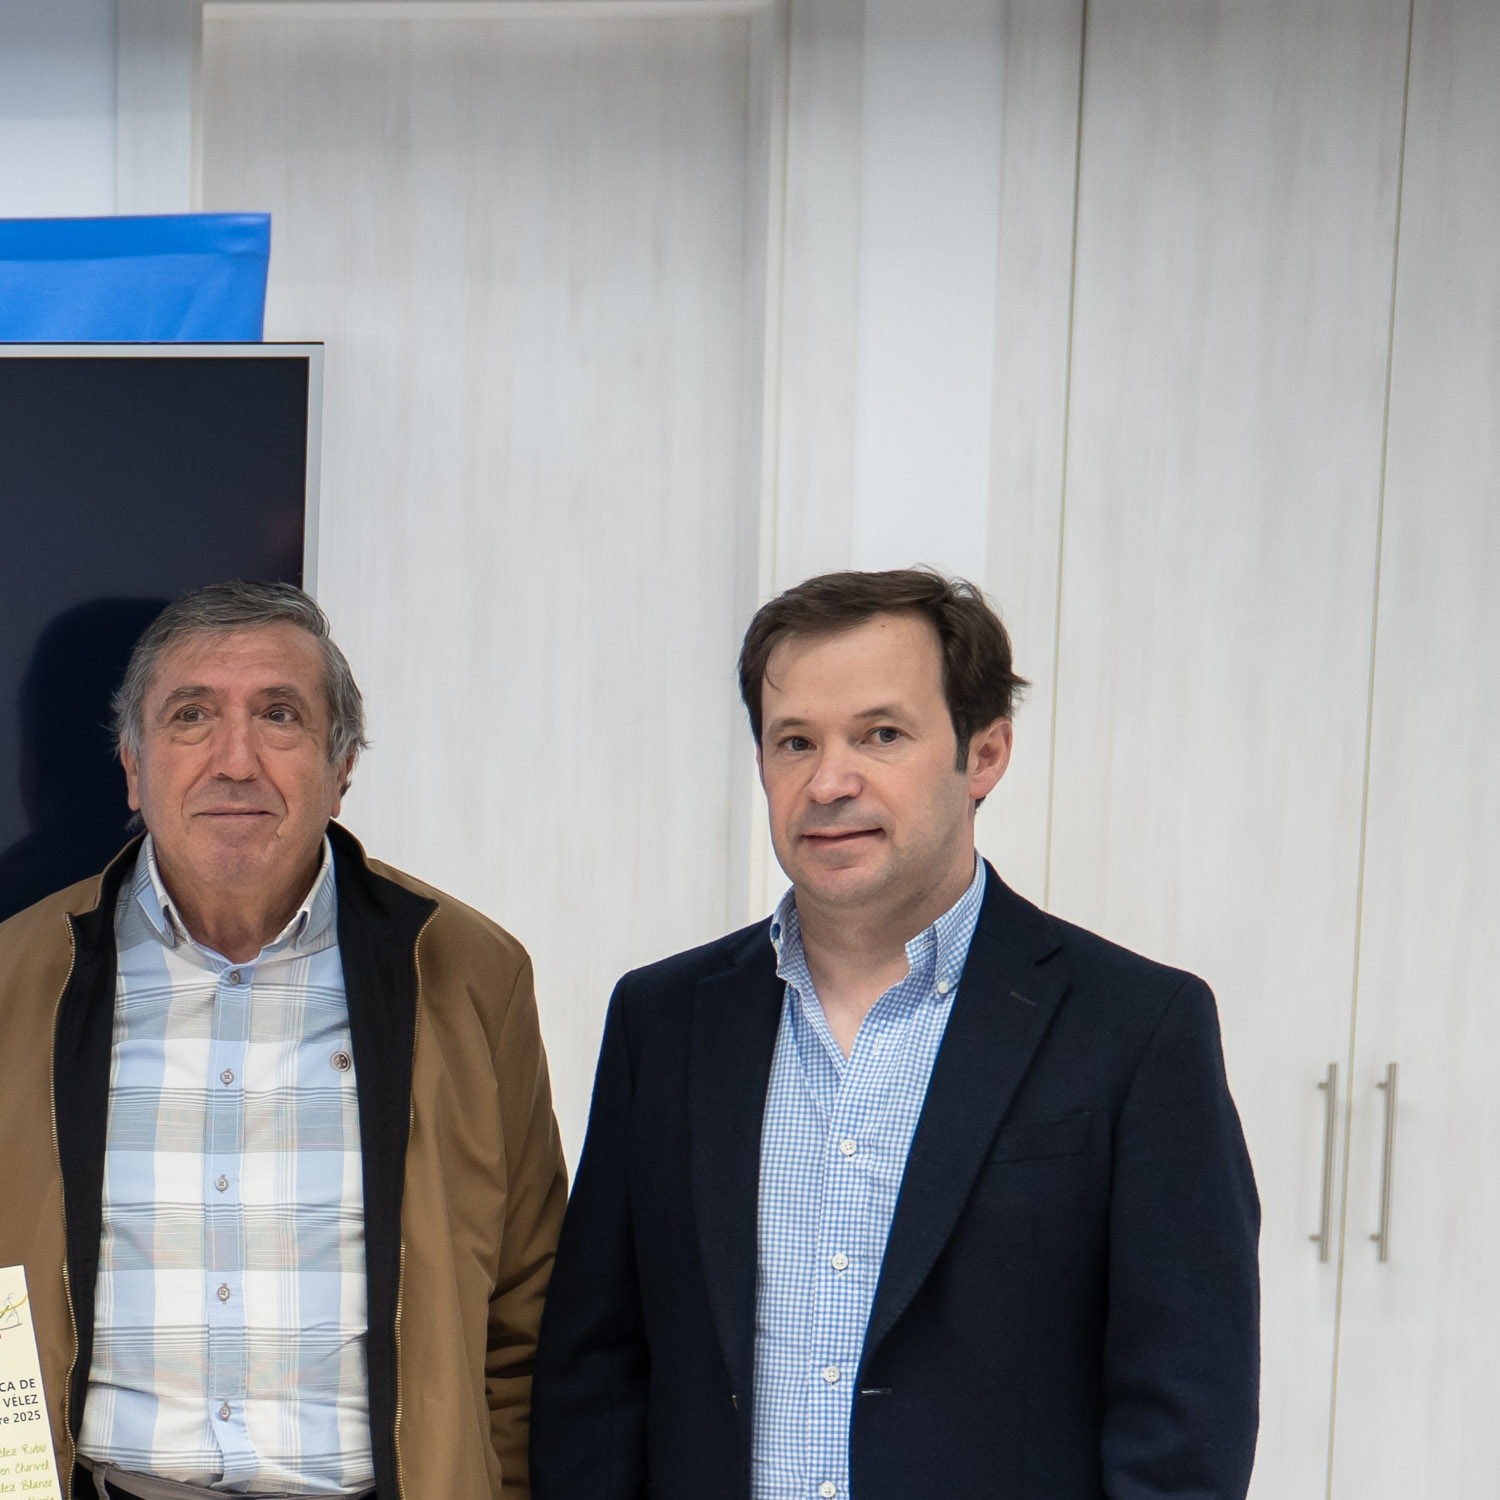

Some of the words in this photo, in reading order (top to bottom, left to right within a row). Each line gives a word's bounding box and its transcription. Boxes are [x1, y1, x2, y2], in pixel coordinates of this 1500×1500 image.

[19, 1378, 36, 1390] DE
[3, 1393, 39, 1408] VÉLEZ
[13, 1409, 41, 1423] 2025
[0, 1467, 11, 1476] en
